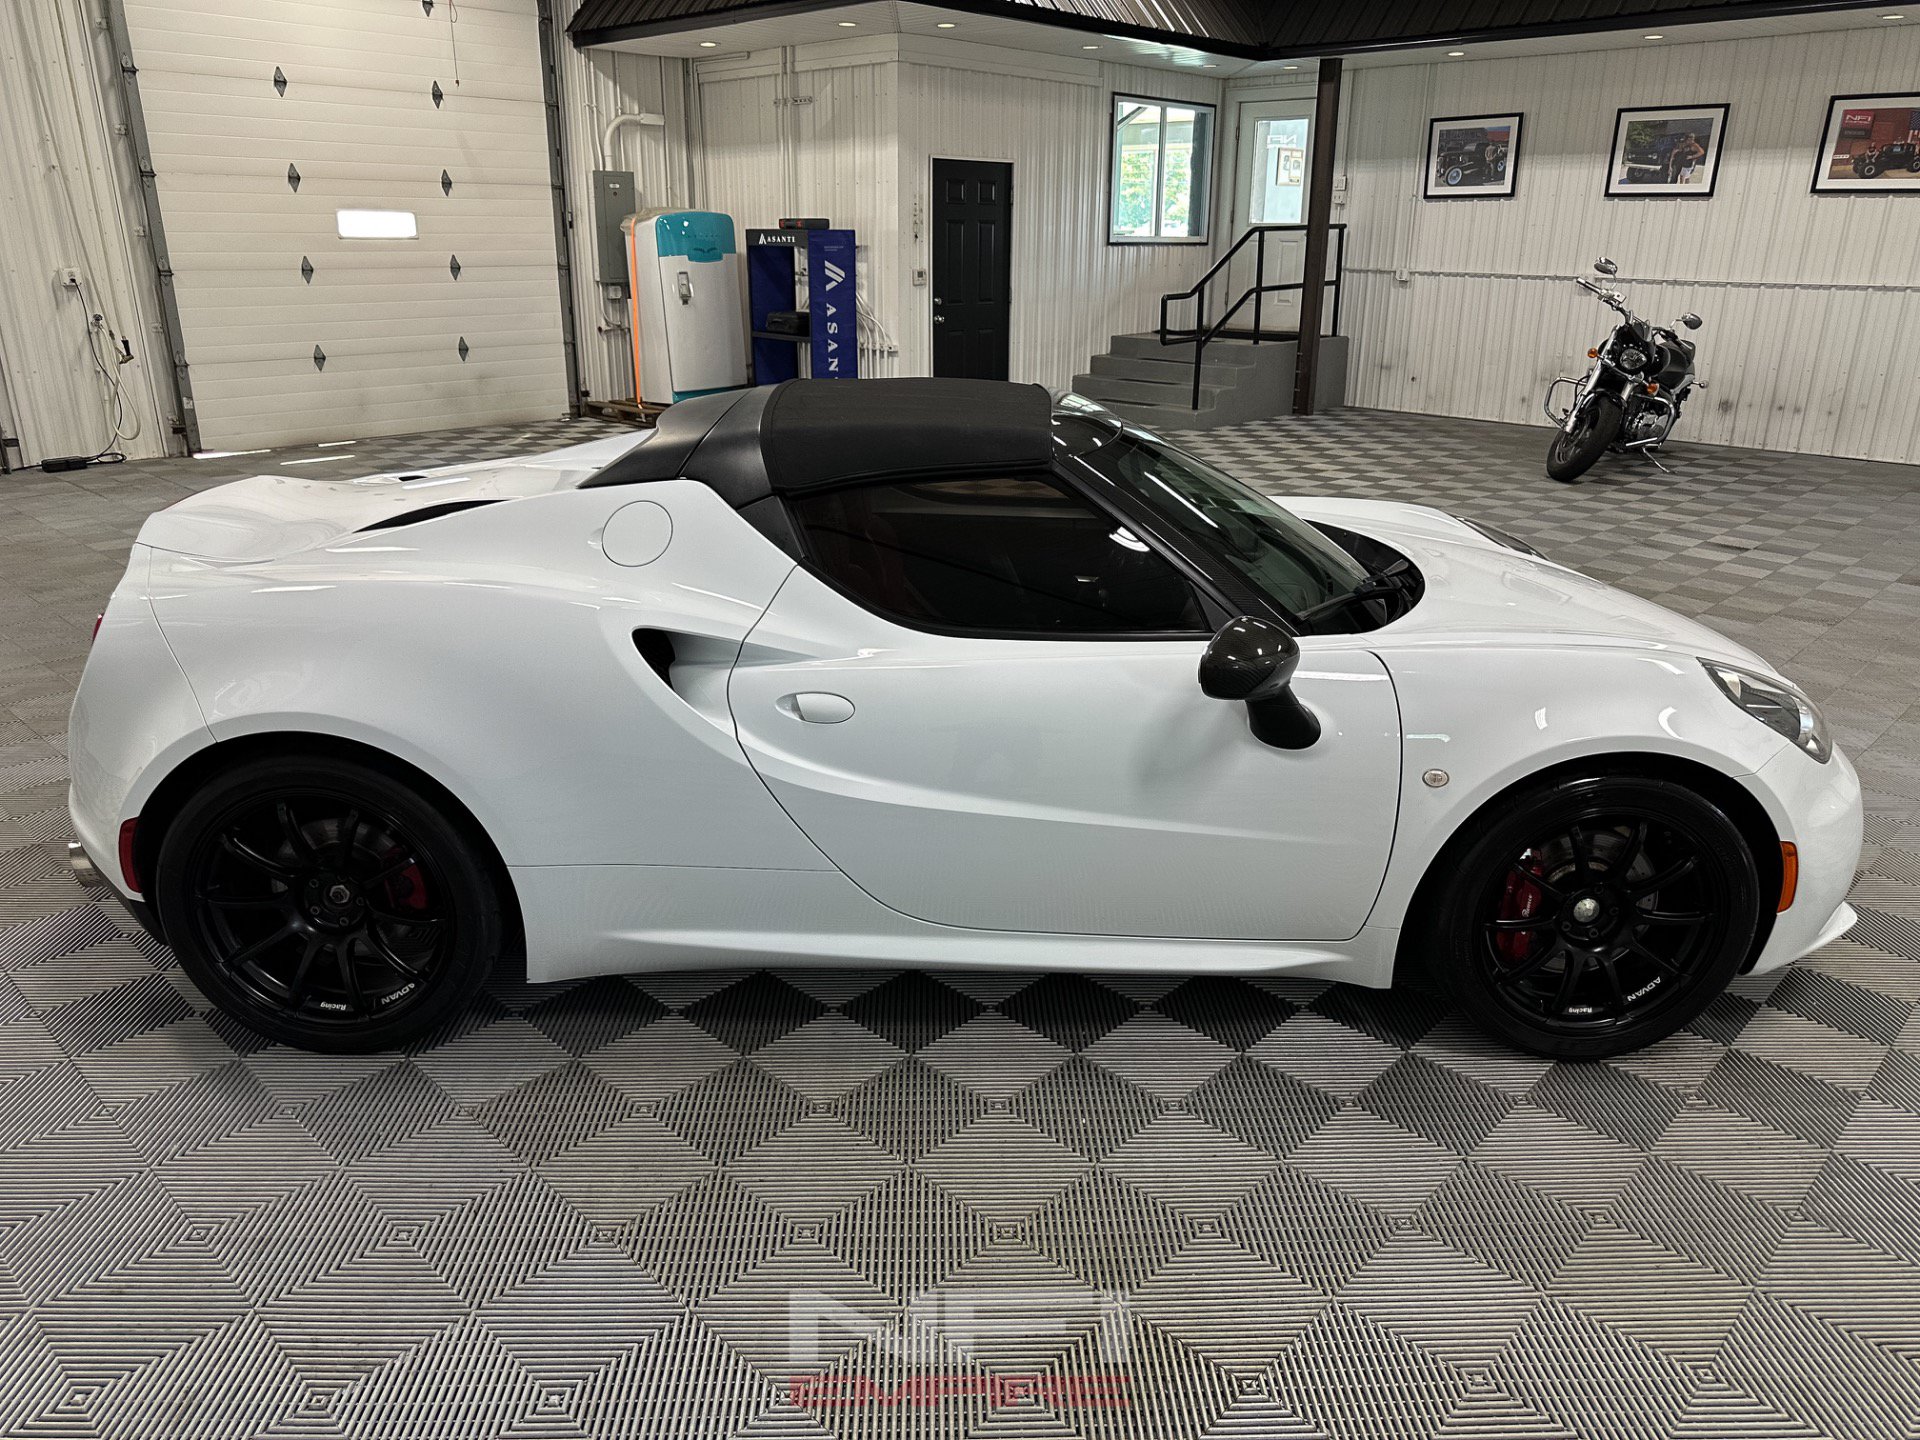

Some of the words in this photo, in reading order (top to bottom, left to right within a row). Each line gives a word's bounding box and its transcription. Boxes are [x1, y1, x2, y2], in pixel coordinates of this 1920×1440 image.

[826, 303, 839, 379] ASAN
[381, 982, 415, 1005] ADVAN
[1627, 976, 1661, 1002] ADVAN
[320, 1001, 347, 1011] Racing
